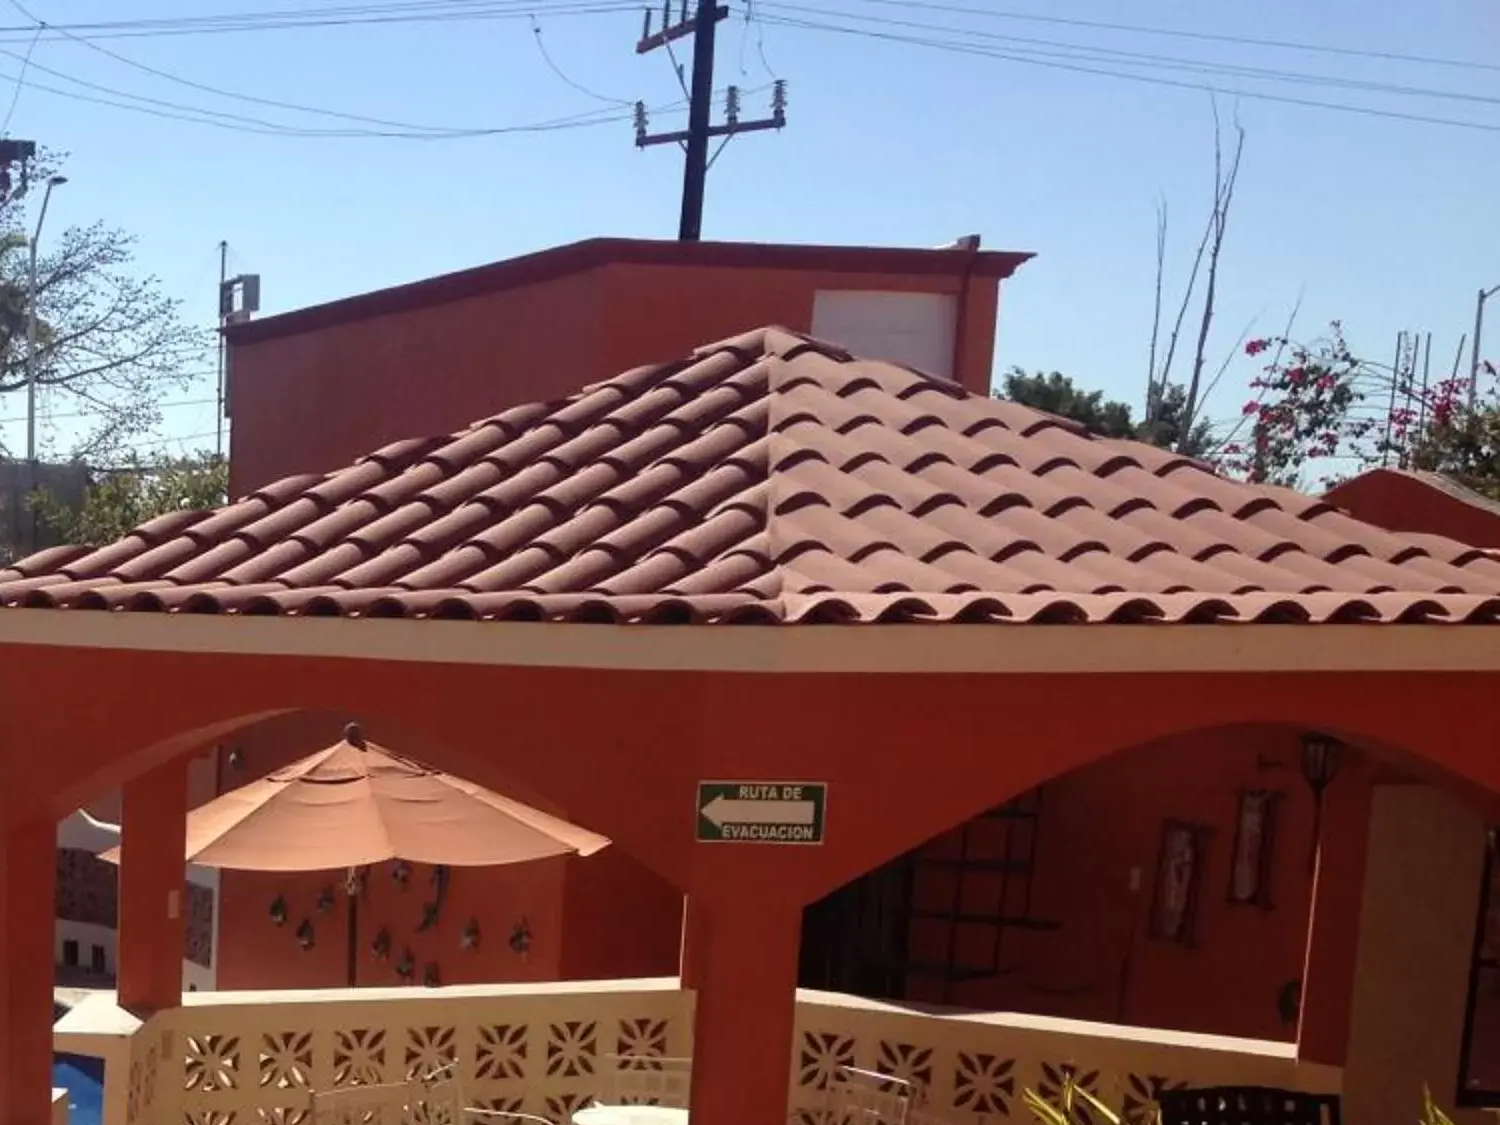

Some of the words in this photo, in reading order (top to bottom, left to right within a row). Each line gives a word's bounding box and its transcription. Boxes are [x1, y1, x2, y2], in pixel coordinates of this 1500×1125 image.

[739, 786, 778, 799] RUTA
[783, 787, 802, 799] DE
[722, 825, 813, 839] EVACUACION
